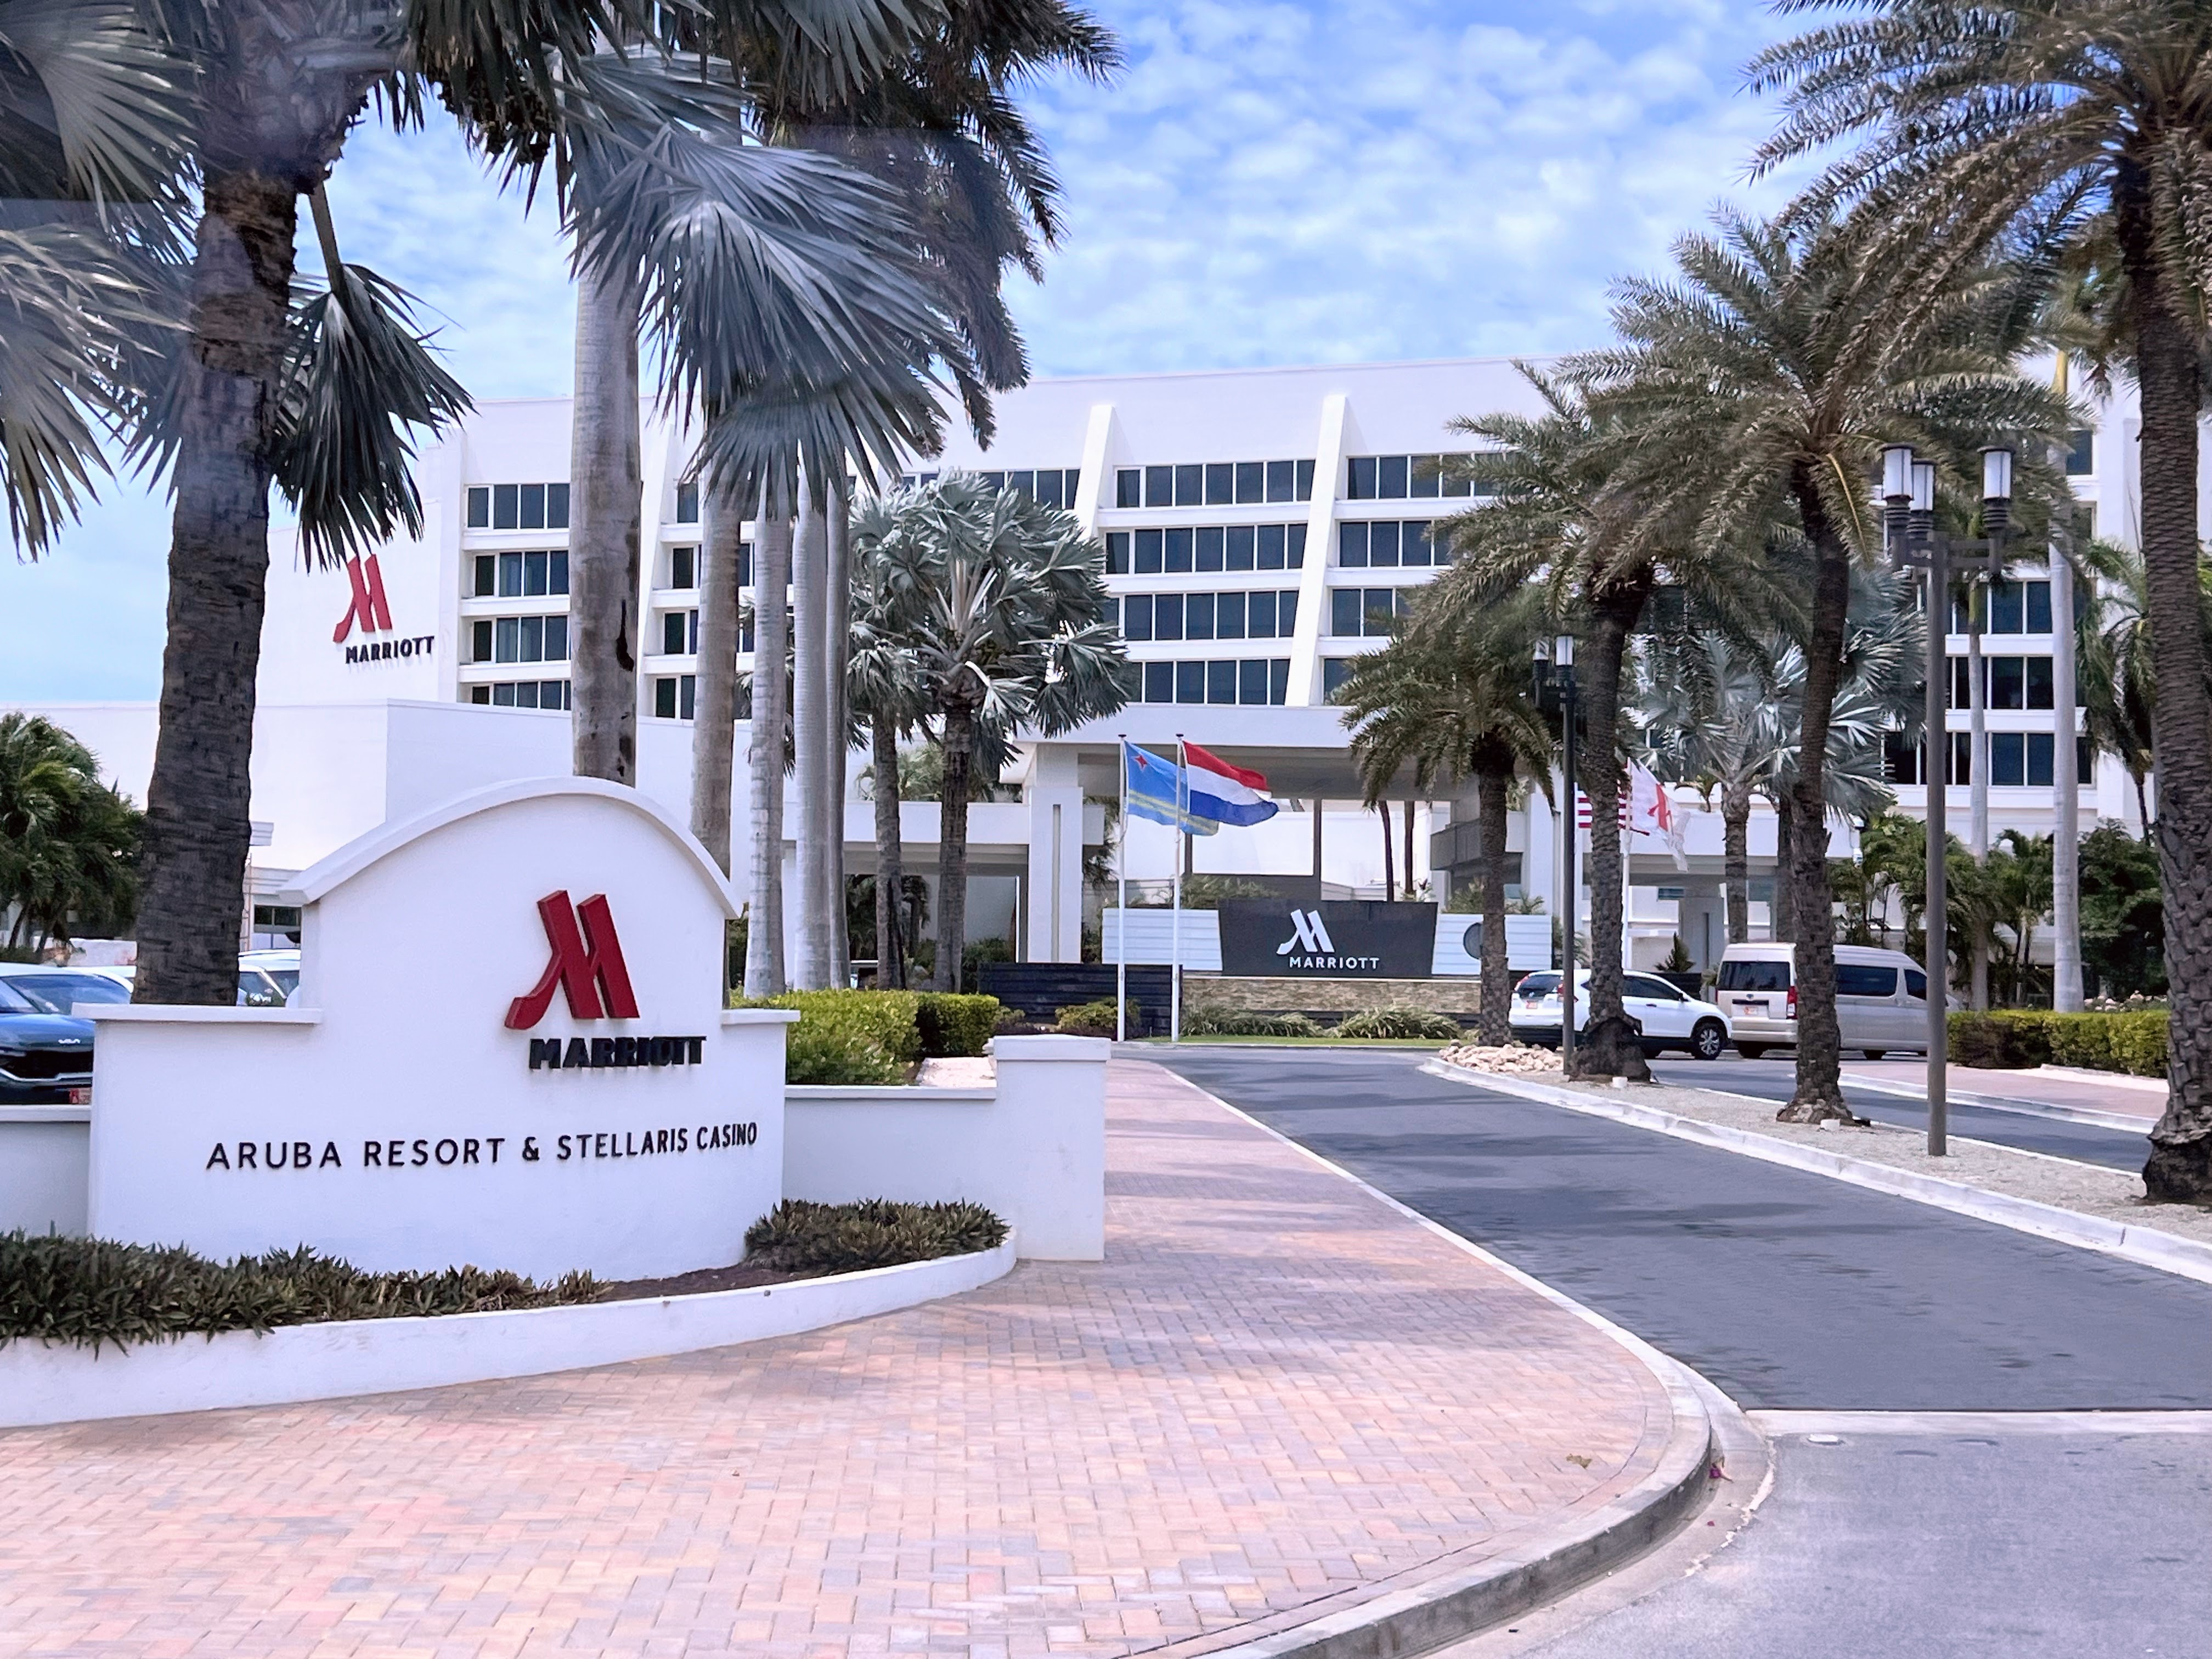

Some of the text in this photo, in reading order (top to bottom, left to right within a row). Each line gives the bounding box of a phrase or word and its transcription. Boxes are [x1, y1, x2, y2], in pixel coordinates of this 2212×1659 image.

[346, 635, 435, 664] MARRIOTT
[1289, 956, 1380, 969] MARRIOTT
[528, 1035, 707, 1070] MARRIOTT
[206, 1122, 757, 1170] ARUBA RESORT & STELLARIS CASINO
